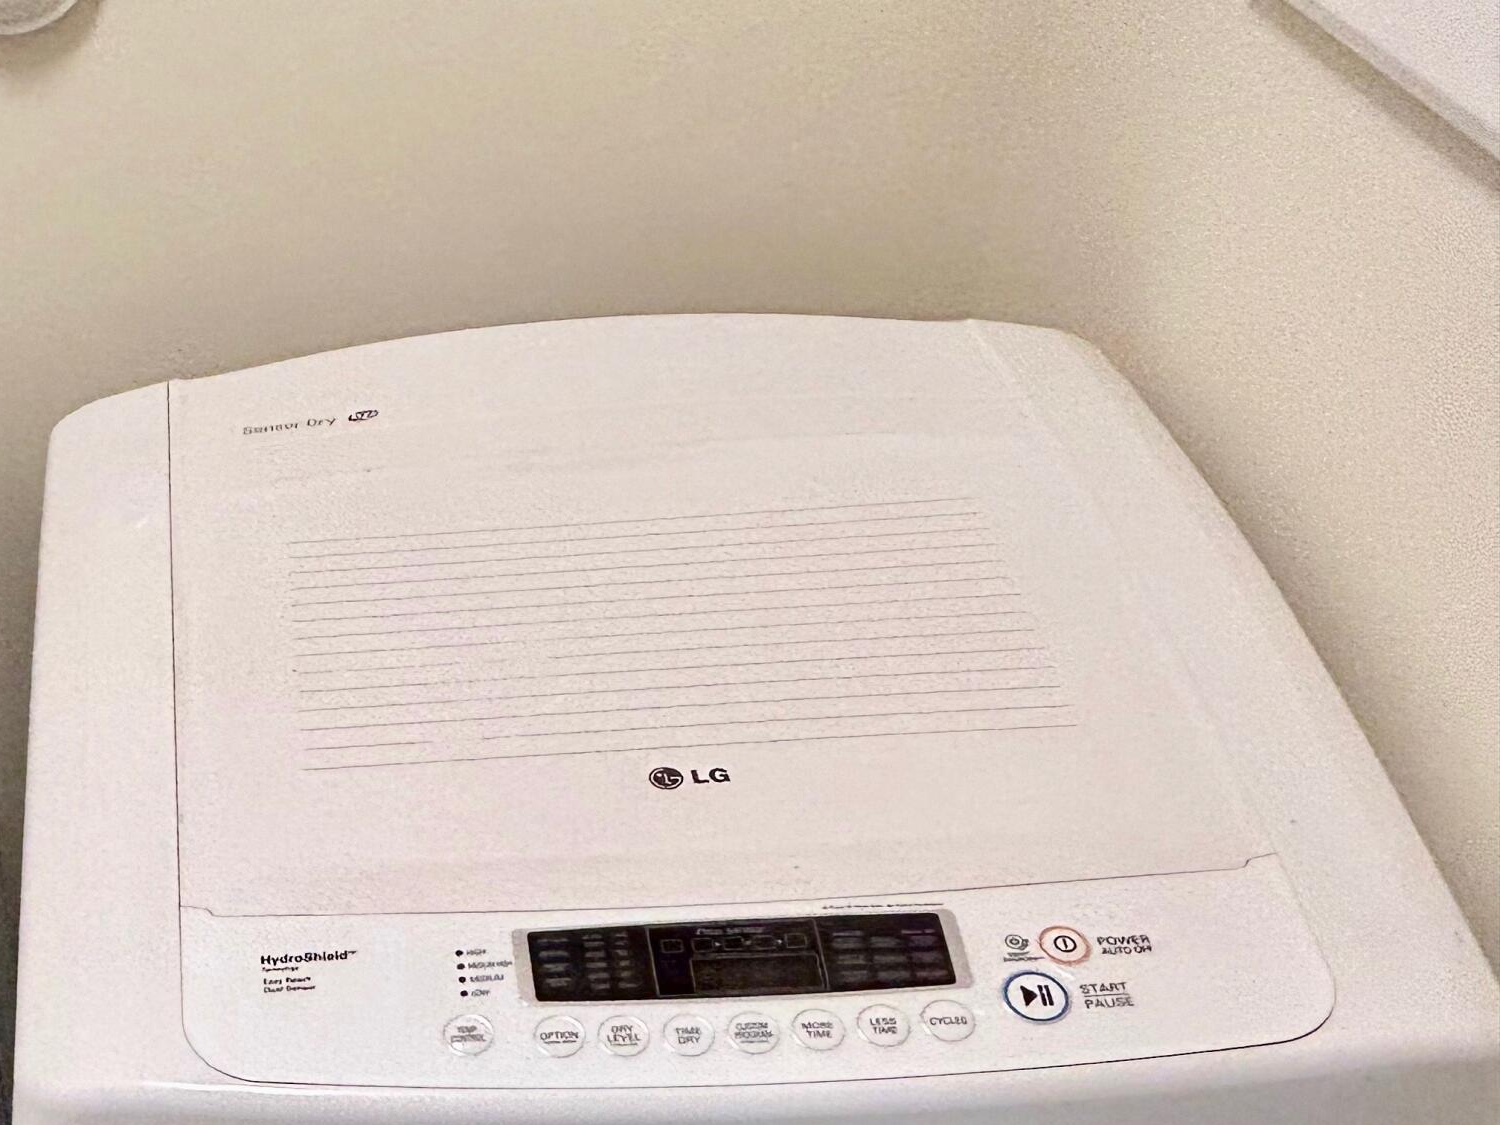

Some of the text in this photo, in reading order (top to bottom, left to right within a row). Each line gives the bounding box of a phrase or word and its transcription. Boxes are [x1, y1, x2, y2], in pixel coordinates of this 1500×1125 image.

[690, 767, 732, 784] LG
[1096, 934, 1151, 946] POWER
[1079, 981, 1129, 994] START
[1084, 996, 1136, 1009] PAUSE
